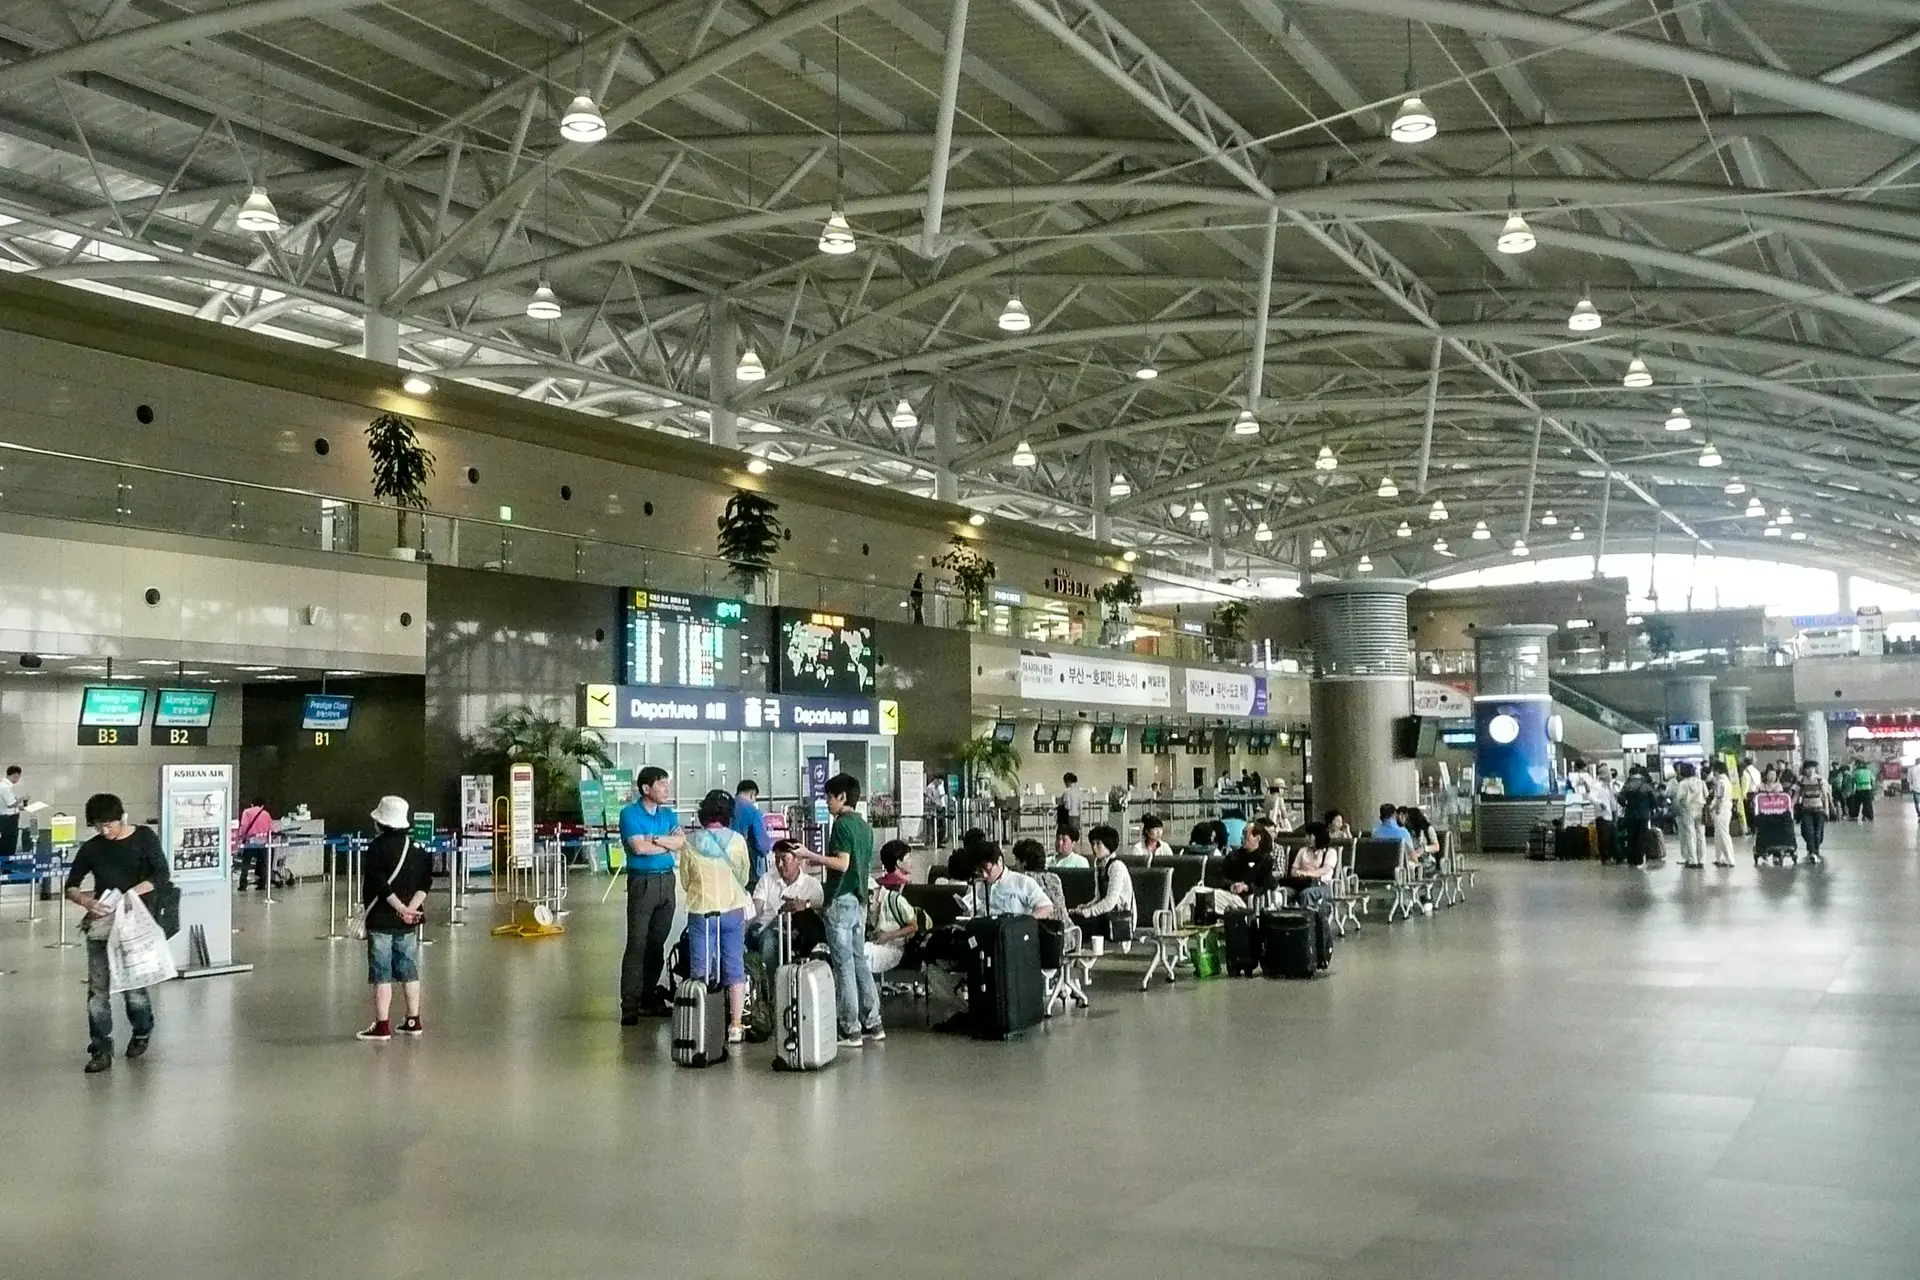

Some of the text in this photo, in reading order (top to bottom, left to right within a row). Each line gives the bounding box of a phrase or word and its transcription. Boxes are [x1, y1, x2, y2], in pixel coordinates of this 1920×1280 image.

[1068, 666, 1085, 685] 부산
[631, 698, 698, 721] Departures
[794, 706, 847, 727] Departures
[98, 728, 118, 744] B3
[170, 728, 189, 744] B2
[315, 731, 330, 746] B1
[173, 769, 224, 778] KOREAN AIR
